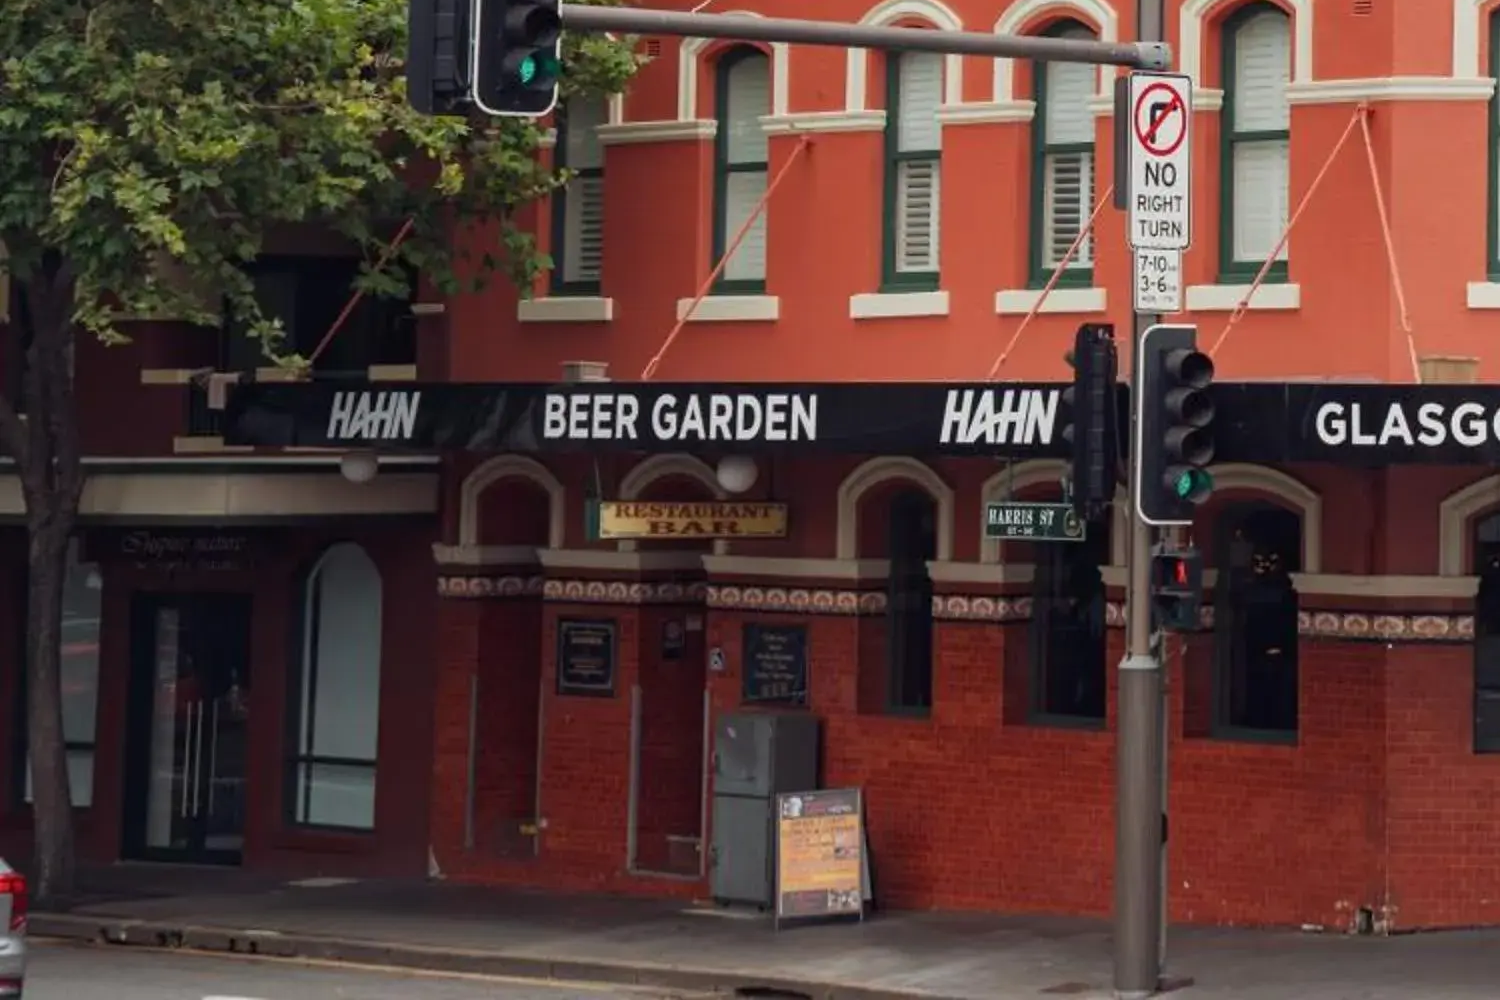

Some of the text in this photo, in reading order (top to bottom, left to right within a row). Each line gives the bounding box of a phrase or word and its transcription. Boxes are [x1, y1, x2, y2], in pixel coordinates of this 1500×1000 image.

[1145, 162, 1177, 187] NO
[1137, 195, 1182, 213] RIGHT
[1139, 219, 1182, 238] TURN
[326, 391, 421, 439] HAHN
[544, 394, 818, 440] BEER GARDEN
[939, 389, 1060, 444] HAHN
[615, 503, 769, 519] RESTAURANT
[988, 508, 1055, 526] HARRIS ST
[648, 521, 740, 534] BAR
